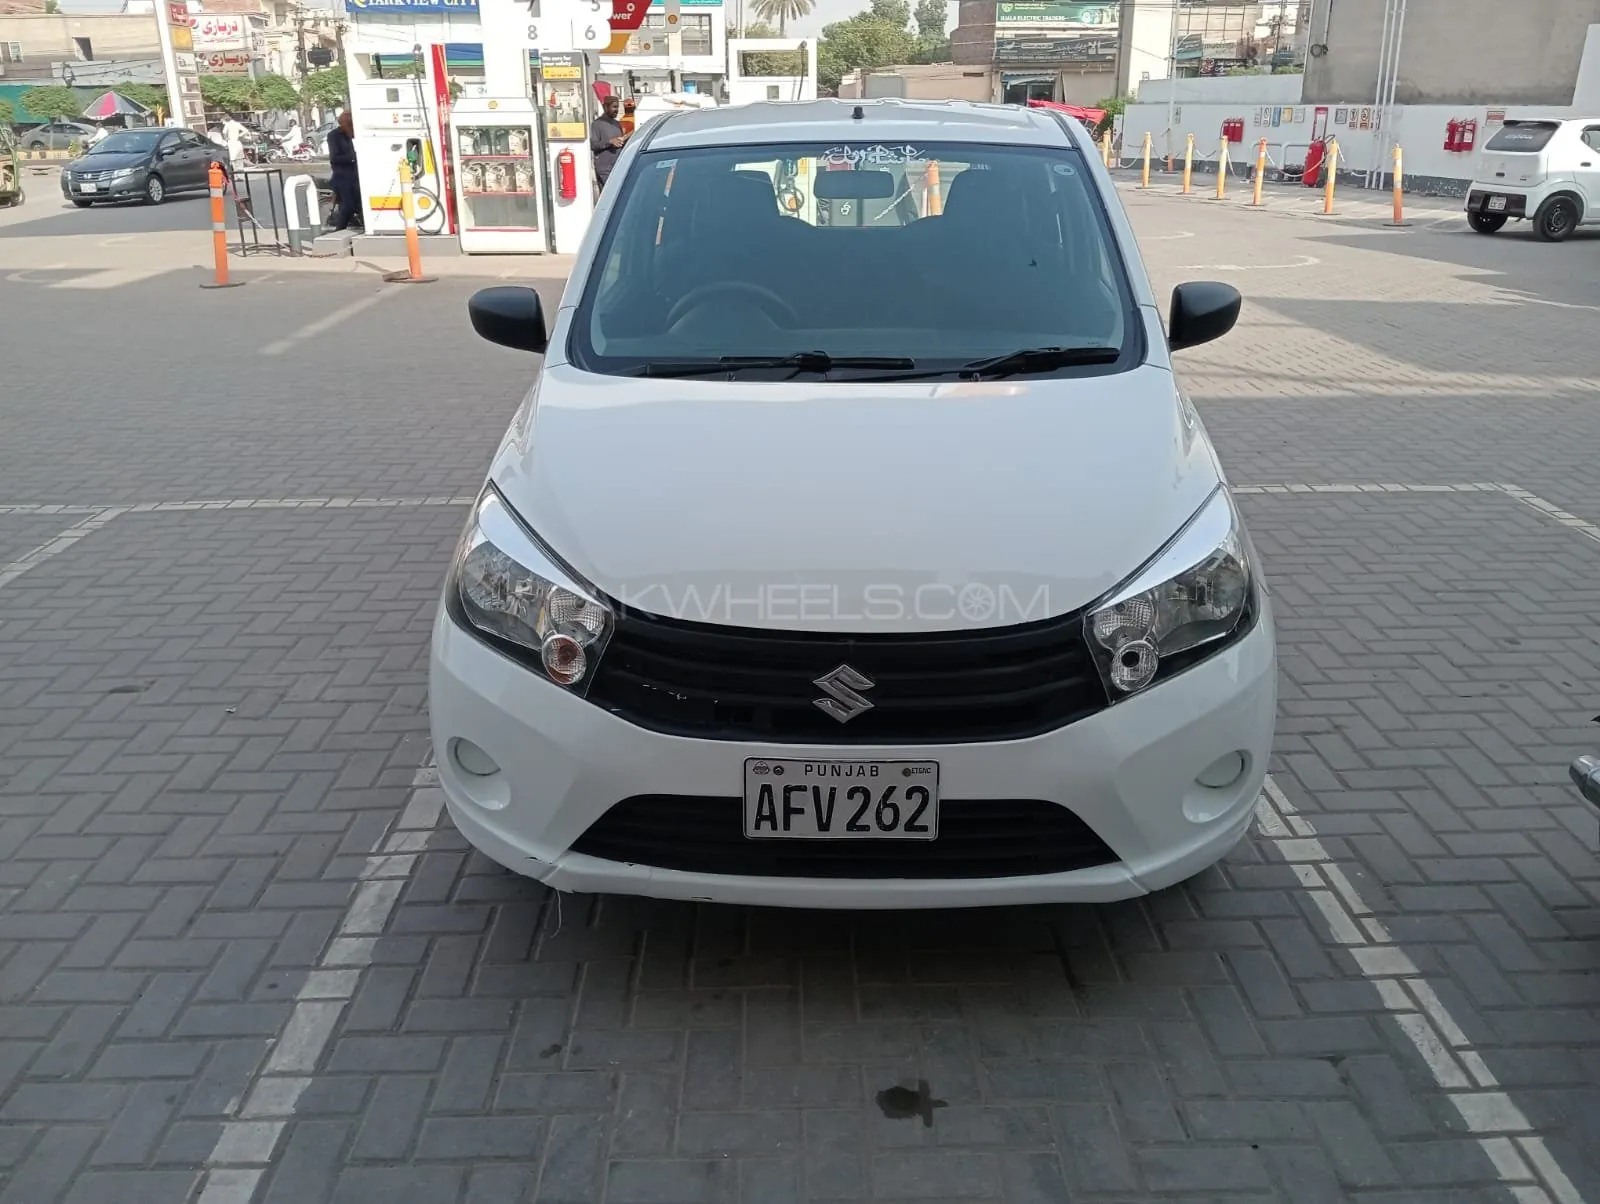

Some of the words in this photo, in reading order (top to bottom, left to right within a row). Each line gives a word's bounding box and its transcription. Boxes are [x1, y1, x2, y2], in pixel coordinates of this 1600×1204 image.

[590, 0, 601, 12] 5
[527, 24, 539, 41] 8
[584, 24, 597, 41] 6
[804, 763, 880, 777] PUNJAB
